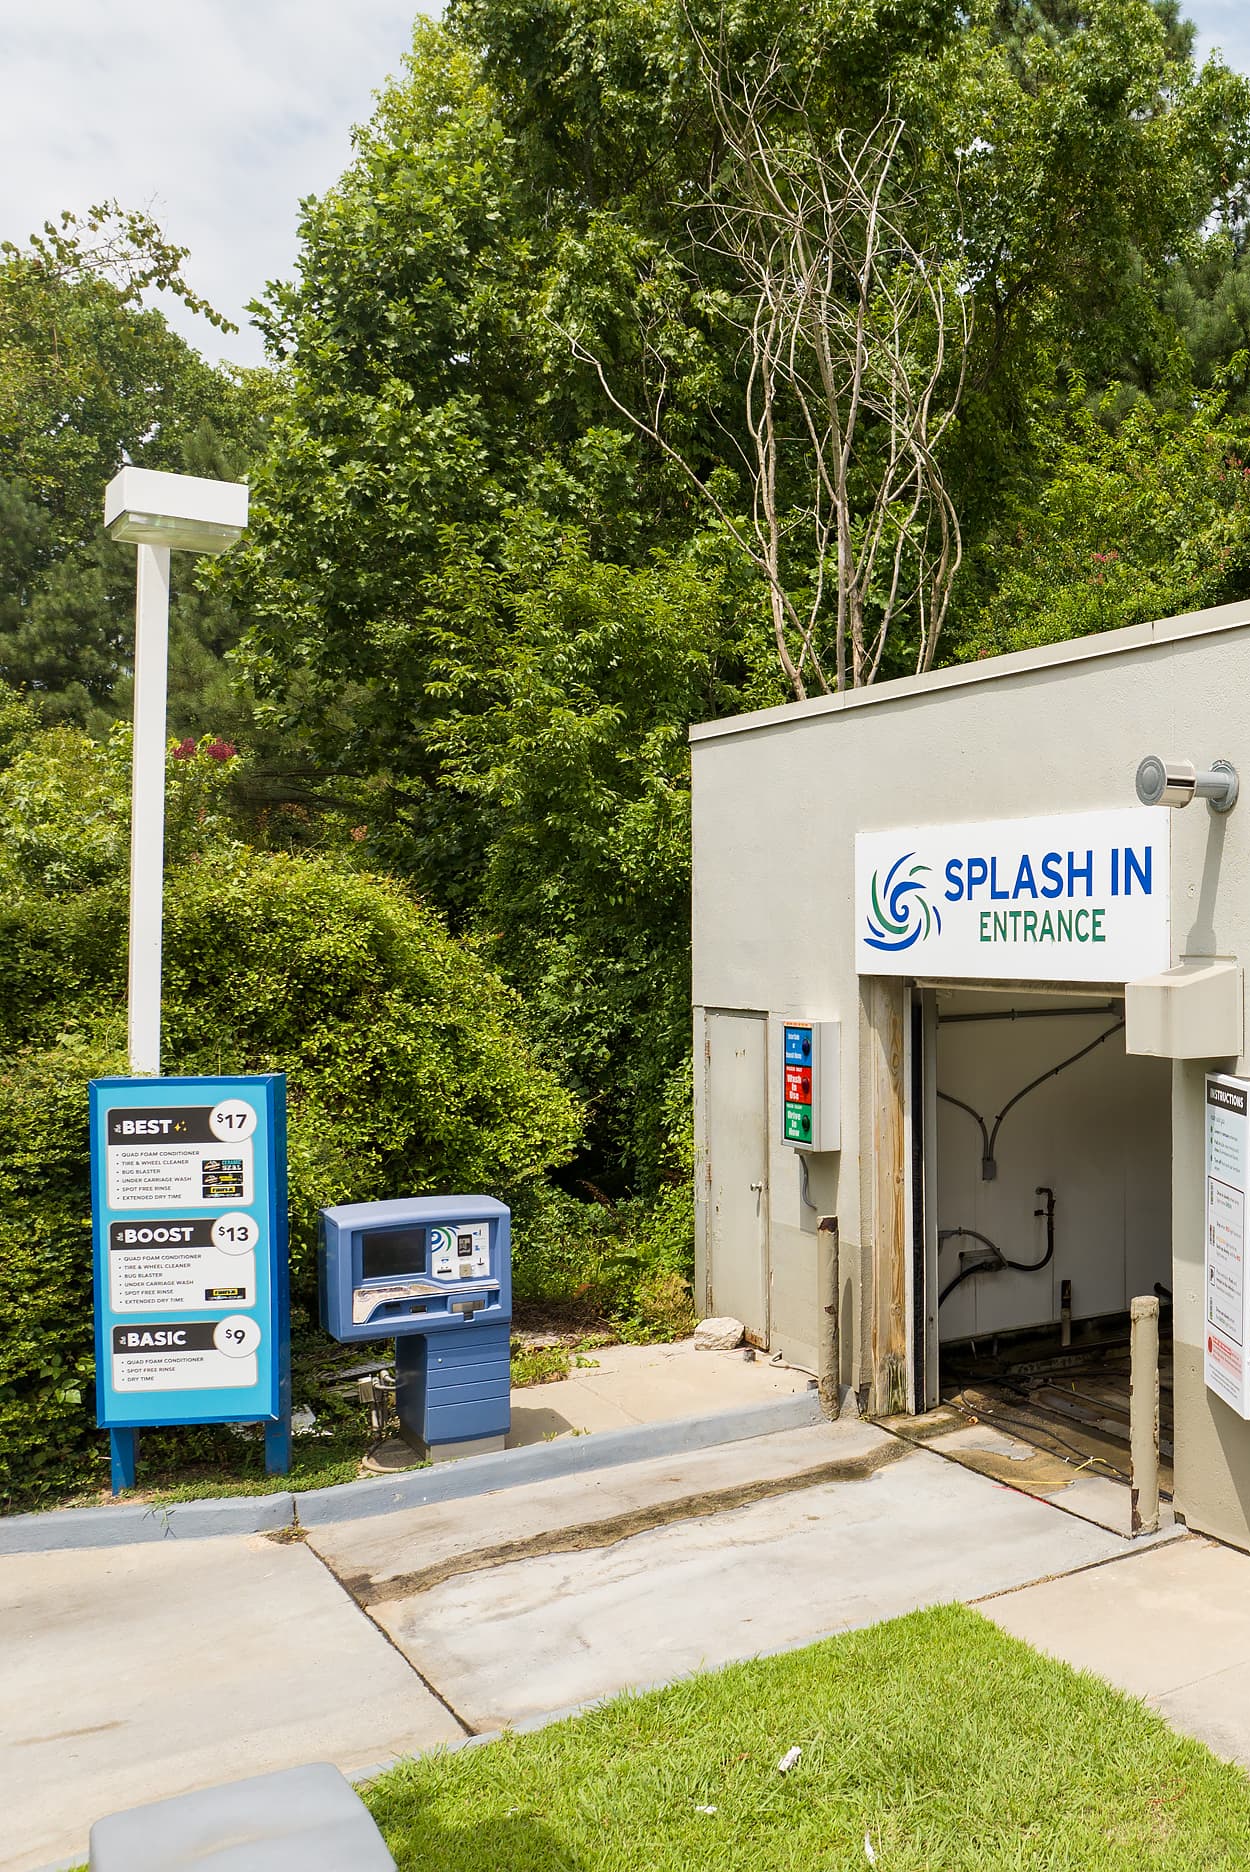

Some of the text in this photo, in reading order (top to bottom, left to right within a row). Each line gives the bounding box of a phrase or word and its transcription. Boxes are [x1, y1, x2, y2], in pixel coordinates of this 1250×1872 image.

[944, 846, 1152, 902] SPLASH IN
[979, 909, 1106, 943] ENTRANCE
[1209, 1087, 1244, 1109] INSTRUCTIONS
[122, 1119, 173, 1135] BEST
[217, 1113, 247, 1129] $17
[125, 1227, 194, 1243] BOOST
[218, 1226, 249, 1241] $13
[127, 1330, 187, 1347] BASIC
[225, 1329, 246, 1345] $9
